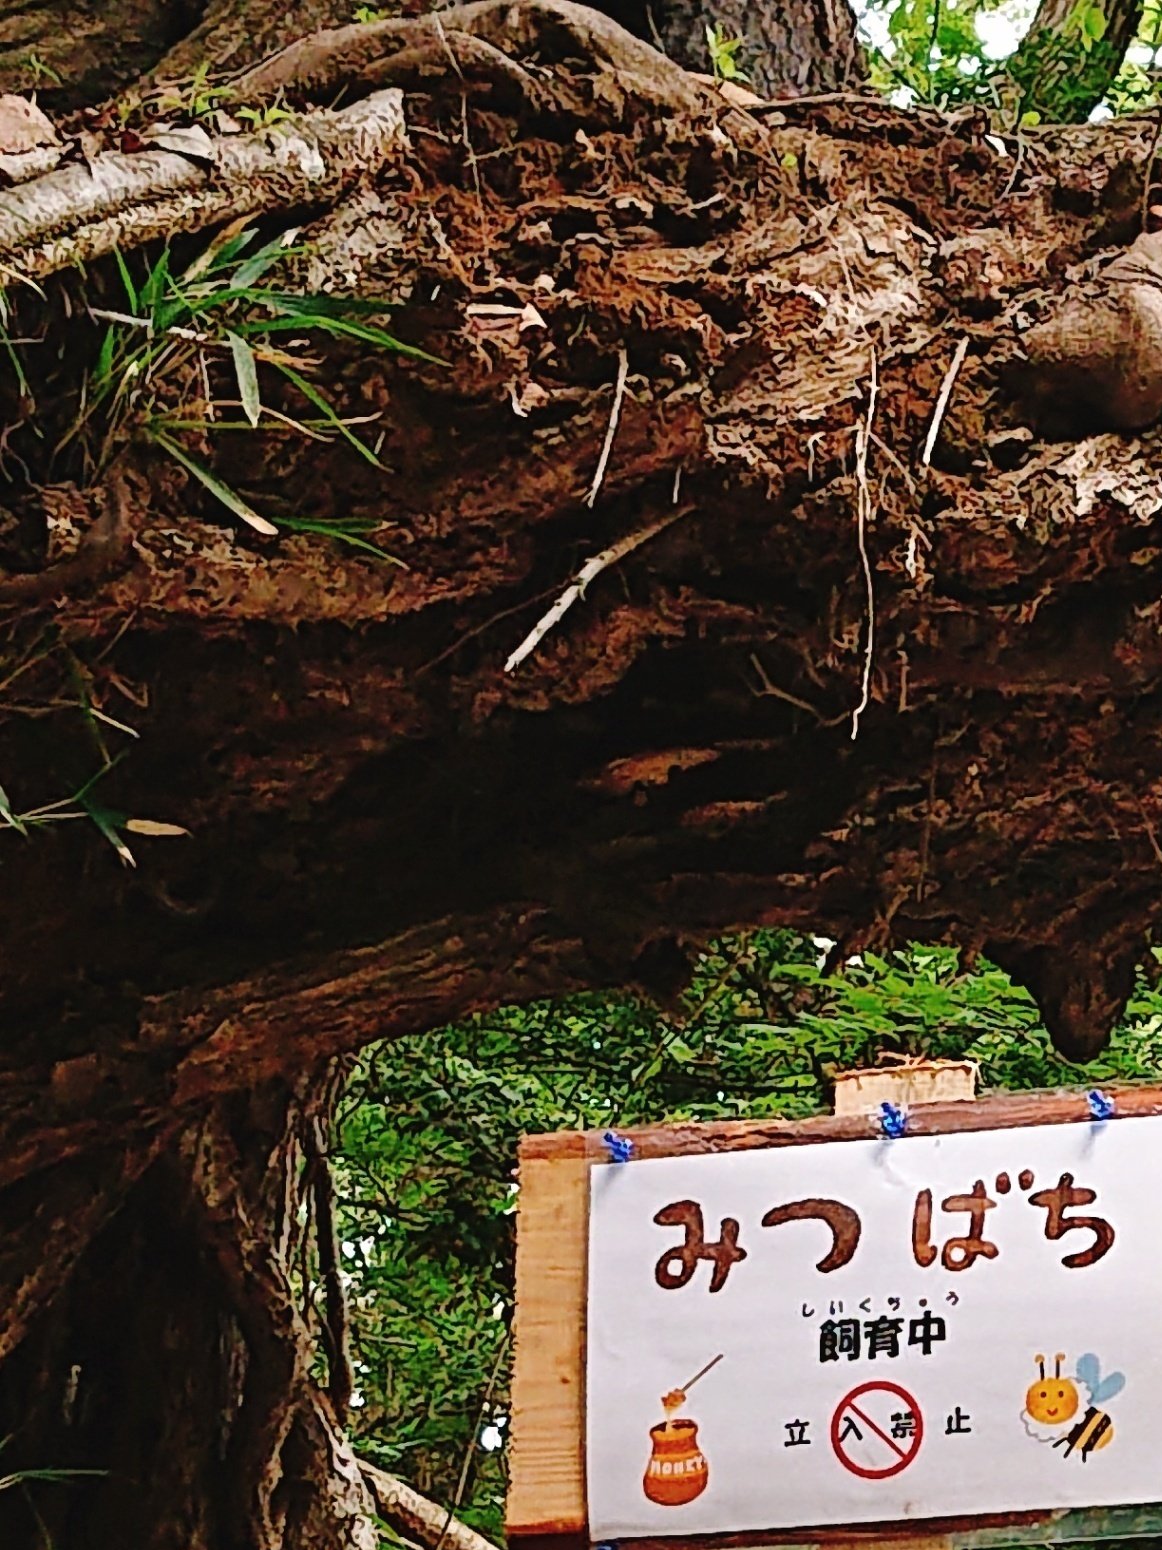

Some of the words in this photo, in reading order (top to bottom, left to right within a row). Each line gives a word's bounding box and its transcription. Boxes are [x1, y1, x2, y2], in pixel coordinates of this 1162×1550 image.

[653, 1169, 1116, 1294] みつばち
[802, 1291, 960, 1318] しいくちう
[820, 1311, 946, 1364] 飼育中
[784, 1406, 972, 1448] 立入禁止
